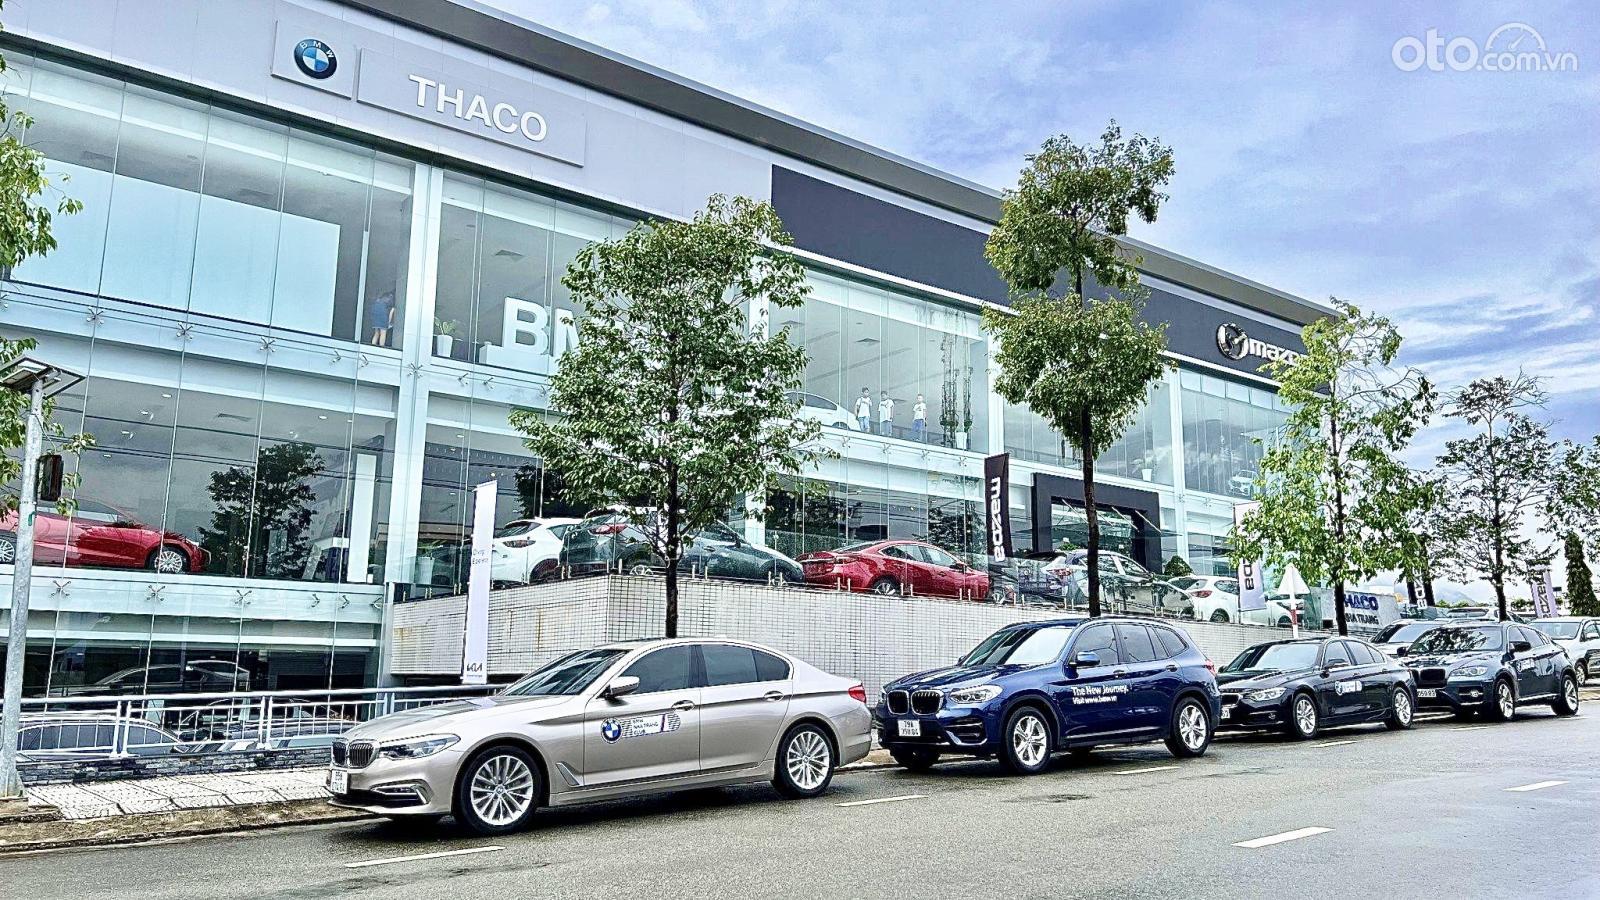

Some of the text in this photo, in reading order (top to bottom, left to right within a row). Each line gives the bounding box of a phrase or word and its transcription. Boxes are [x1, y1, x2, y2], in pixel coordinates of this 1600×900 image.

[408, 74, 548, 143] THACO
[1248, 337, 1310, 368] mazd
[990, 477, 1005, 562] mazda
[1343, 594, 1380, 611] HACO
[1071, 686, 1086, 696] The
[1085, 685, 1102, 695] New
[1072, 696, 1085, 705] Visit
